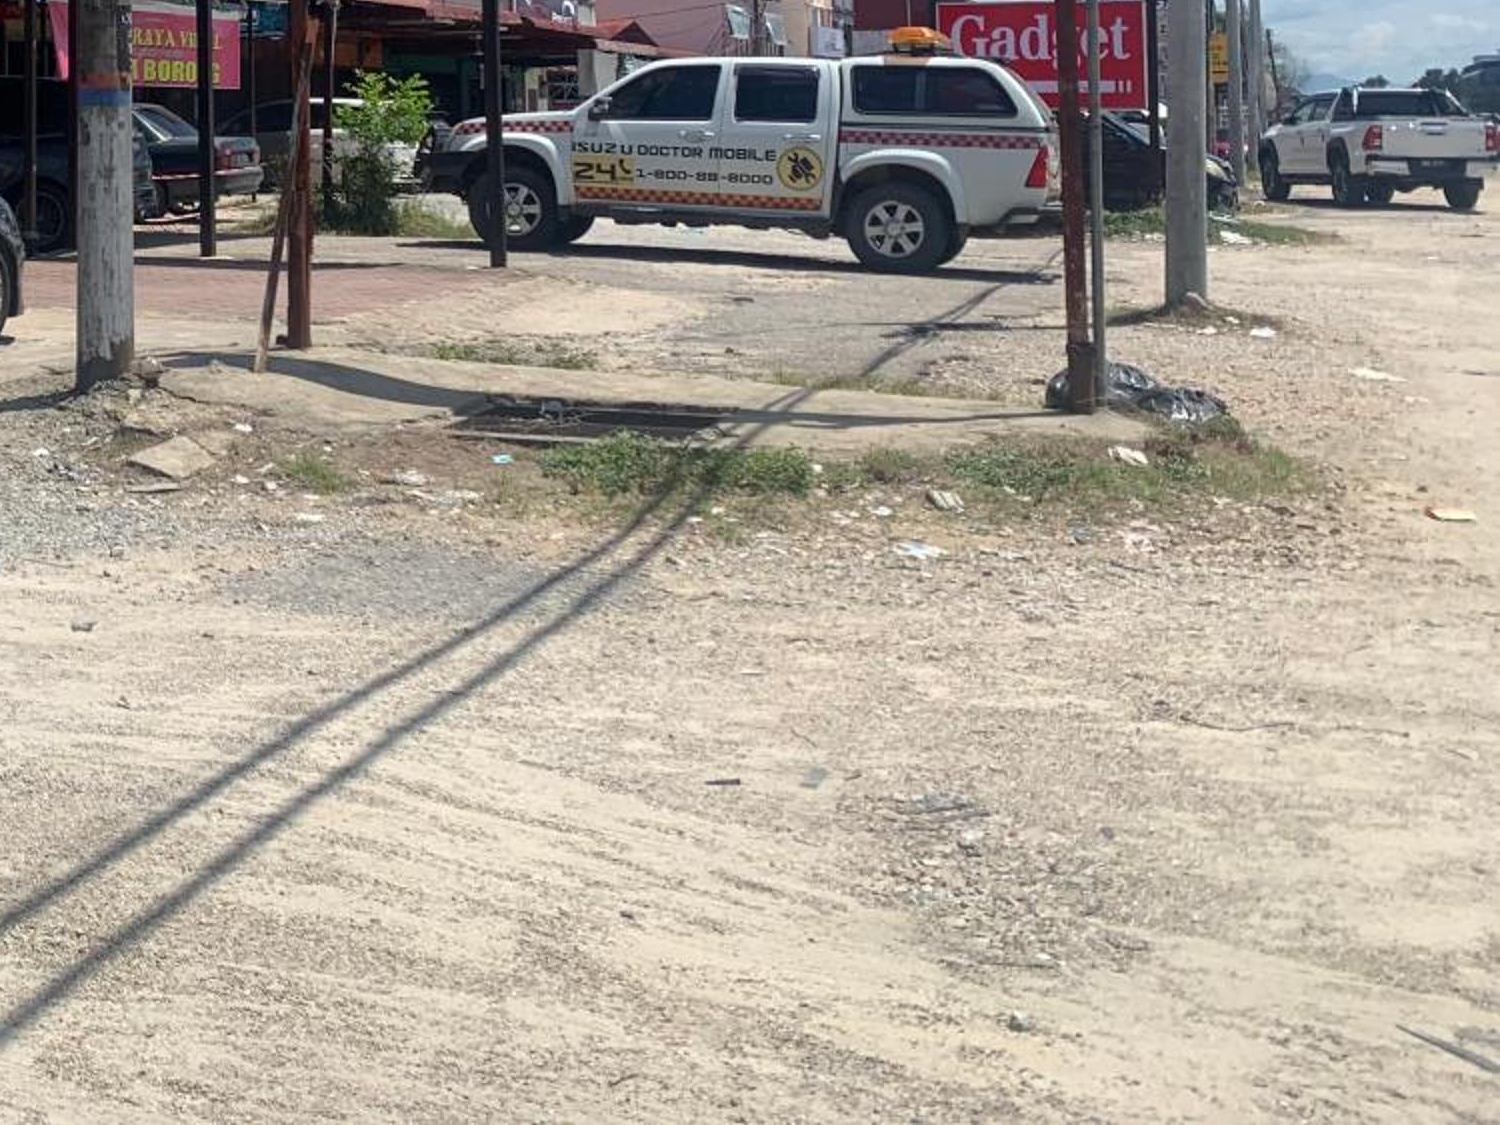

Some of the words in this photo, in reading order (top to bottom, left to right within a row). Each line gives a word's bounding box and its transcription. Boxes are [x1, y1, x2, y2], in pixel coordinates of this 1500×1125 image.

[950, 13, 1132, 69] Gadet
[143, 58, 221, 84] BOROG
[571, 140, 634, 156] ISUZU
[636, 144, 703, 159] DOCTOR
[708, 147, 777, 162] MOBILE
